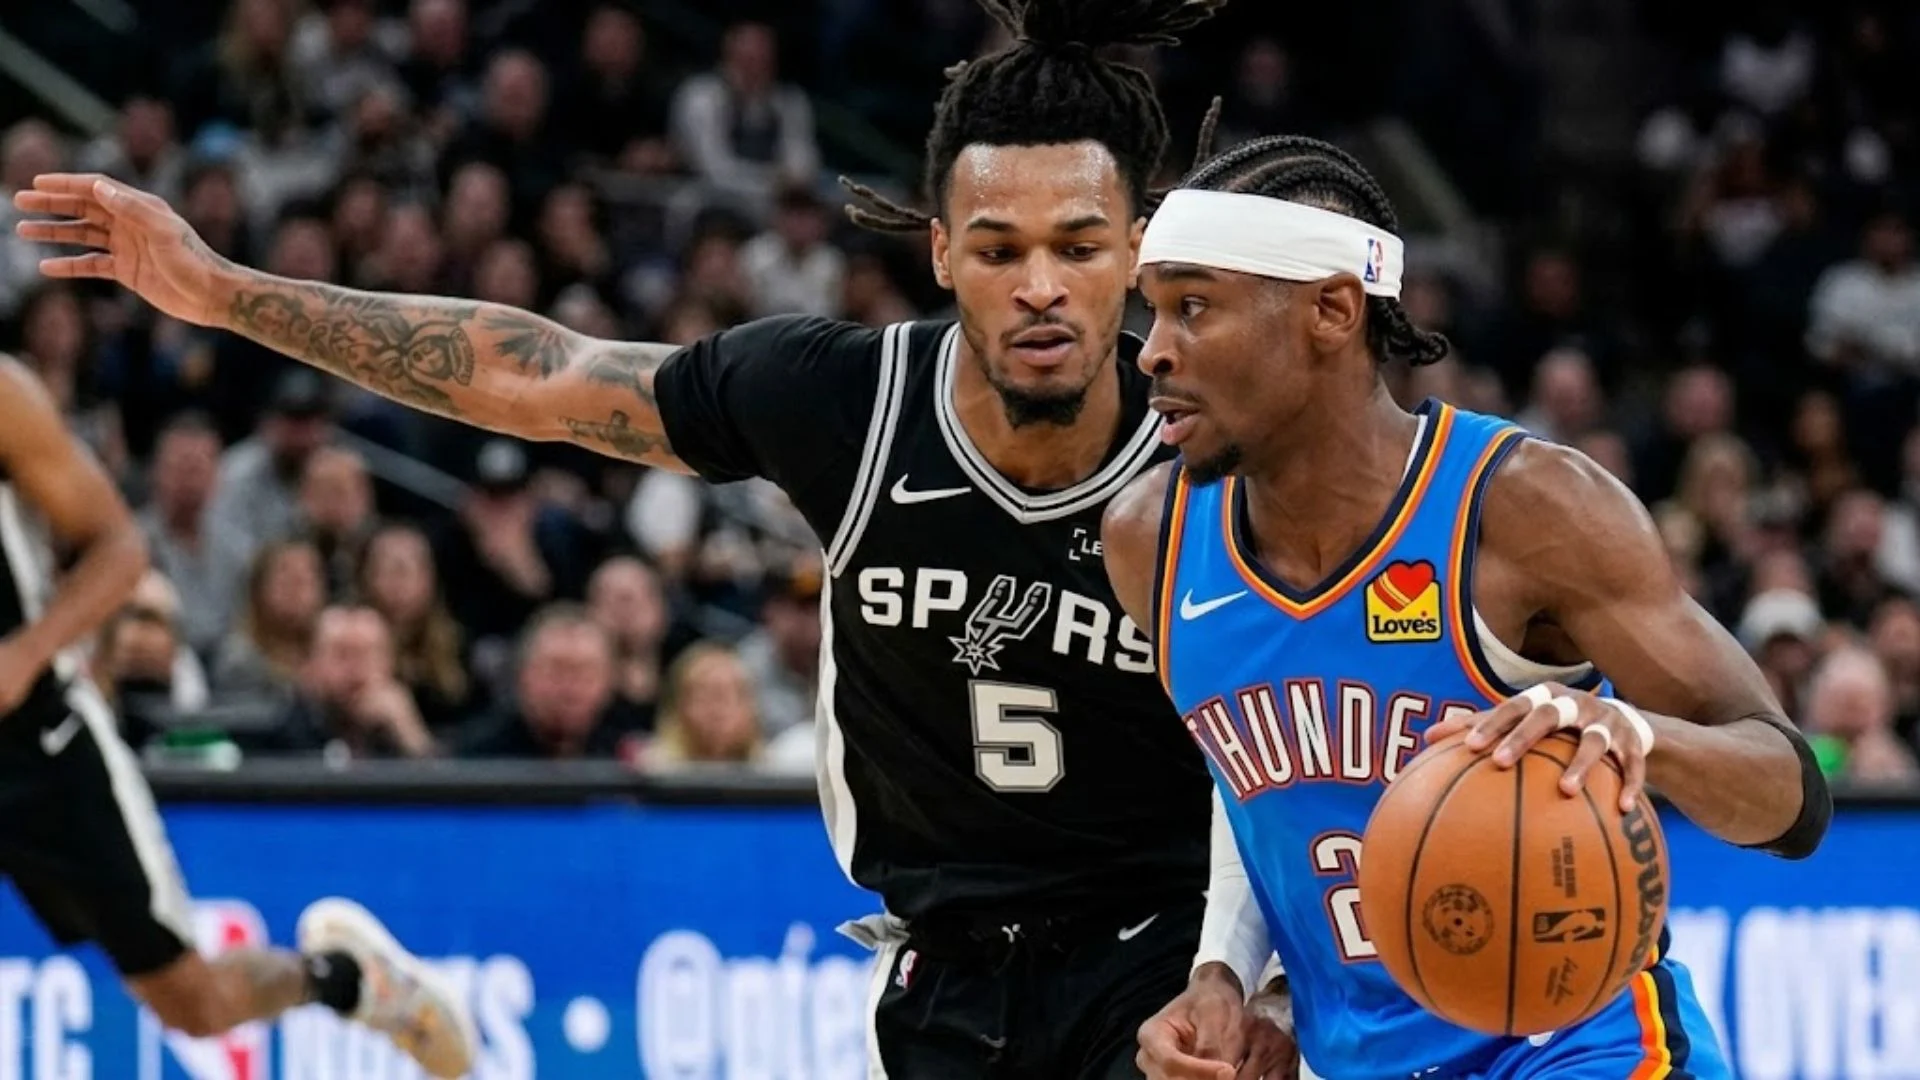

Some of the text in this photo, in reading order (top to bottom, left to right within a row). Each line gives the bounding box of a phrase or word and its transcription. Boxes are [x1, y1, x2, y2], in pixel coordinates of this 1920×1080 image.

[858, 566, 1157, 675] SPURS
[967, 678, 1066, 793] 5
[1182, 677, 1479, 803] HUNDE
[1309, 829, 1381, 965] 2
